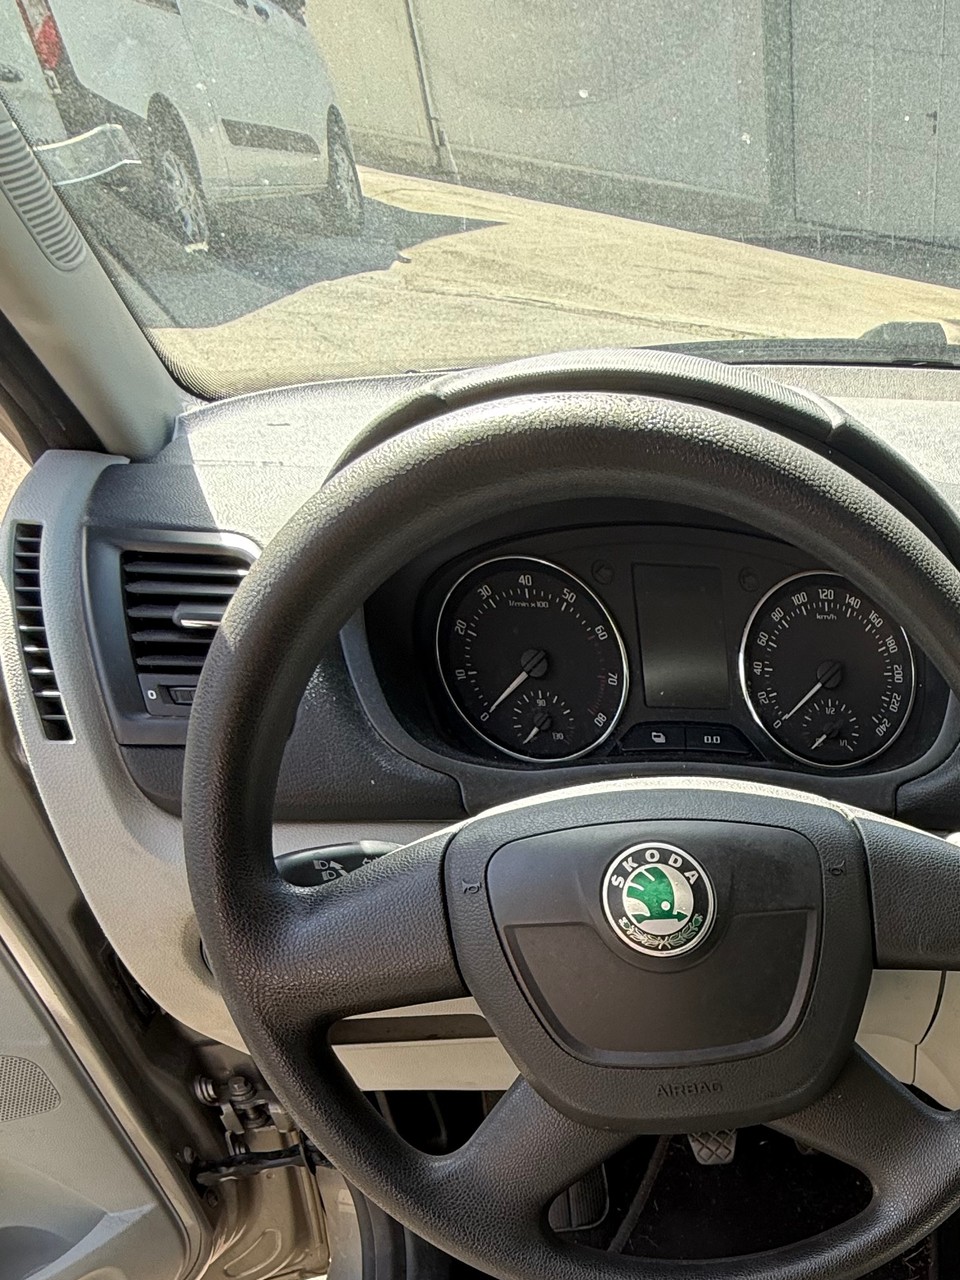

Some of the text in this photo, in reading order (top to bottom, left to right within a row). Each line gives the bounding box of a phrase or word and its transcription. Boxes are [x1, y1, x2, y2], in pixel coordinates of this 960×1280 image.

[518, 574, 532, 586] 40
[477, 584, 492, 600] 30
[562, 588, 577, 603] 50
[791, 591, 808, 606] 100
[818, 588, 834, 600] 120
[845, 593, 862, 609] 140
[770, 606, 784, 622] 80
[816, 612, 837, 620] km/h
[868, 609, 884, 628] 160
[454, 619, 467, 635] 20
[594, 625, 608, 640] 60
[756, 631, 769, 647] 60
[885, 634, 898, 654] 180
[455, 669, 466, 681] 10
[753, 661, 763, 676] 40
[893, 664, 903, 683] 200
[607, 672, 618, 686] 70
[757, 691, 769, 704] 20
[889, 692, 901, 713] 220
[593, 712, 607, 727] 80
[875, 718, 891, 737] 240
[656, 1080, 723, 1098] AIRBAG
